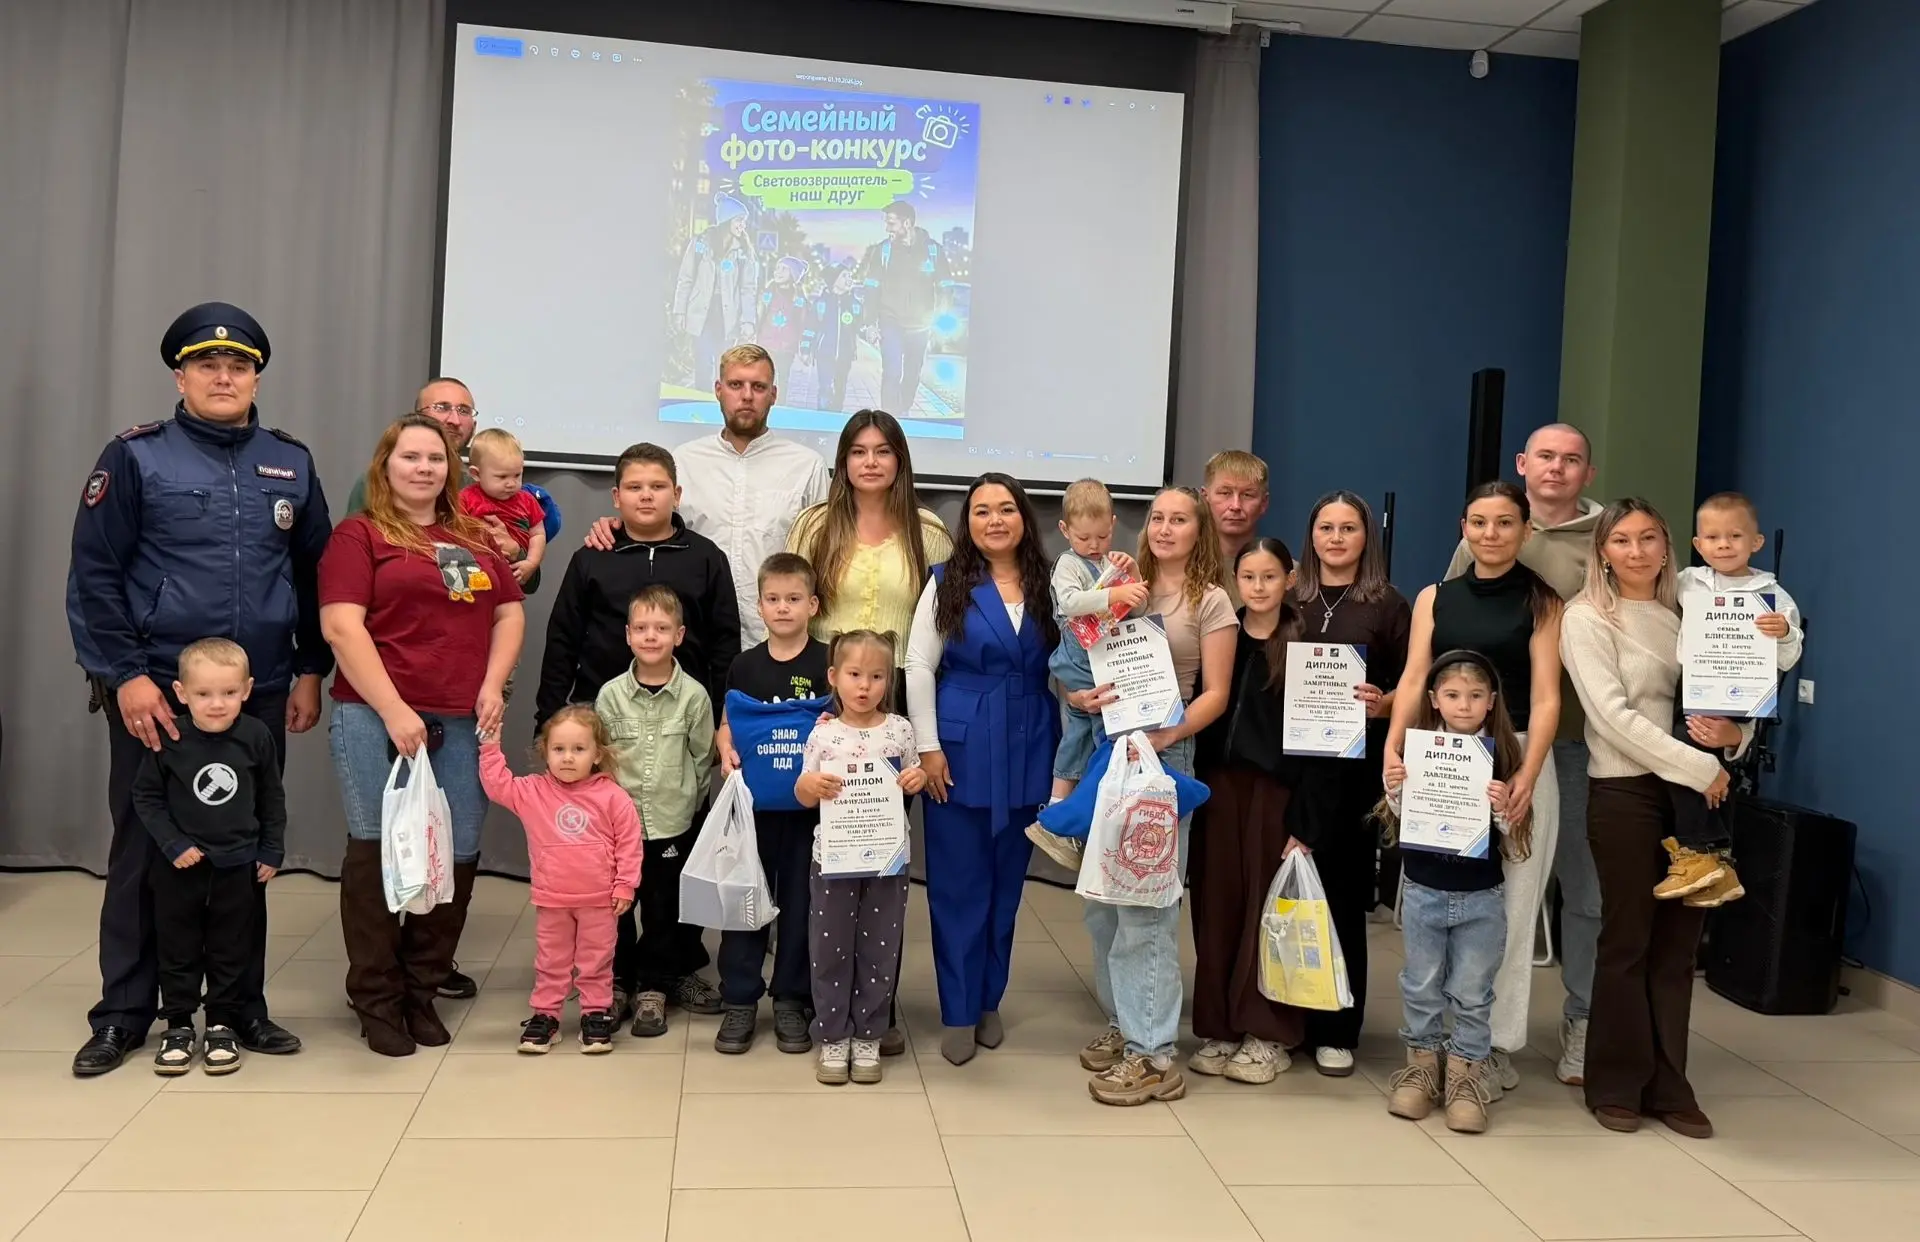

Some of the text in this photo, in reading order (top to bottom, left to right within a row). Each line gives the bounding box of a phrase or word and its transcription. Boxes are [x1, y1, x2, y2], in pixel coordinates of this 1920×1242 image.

[741, 102, 896, 133] Семейный
[720, 133, 926, 170] фото-конкурс
[754, 174, 888, 189] Световозвращатель
[790, 189, 865, 205] наш друг
[1705, 612, 1754, 620] ДИПЛОМ
[1106, 636, 1148, 651] ДИПЛОМ
[1306, 661, 1347, 670] ДИПЛОМ
[772, 729, 798, 740] ЗНАЮ
[1425, 750, 1471, 762] ДИПЛОМ
[773, 757, 792, 770] ПДД
[840, 777, 883, 787] ДИПЛОМ
[1423, 771, 1470, 781] ДАВЛЕЕВЫХ
[1139, 809, 1165, 819] ГИБДД
